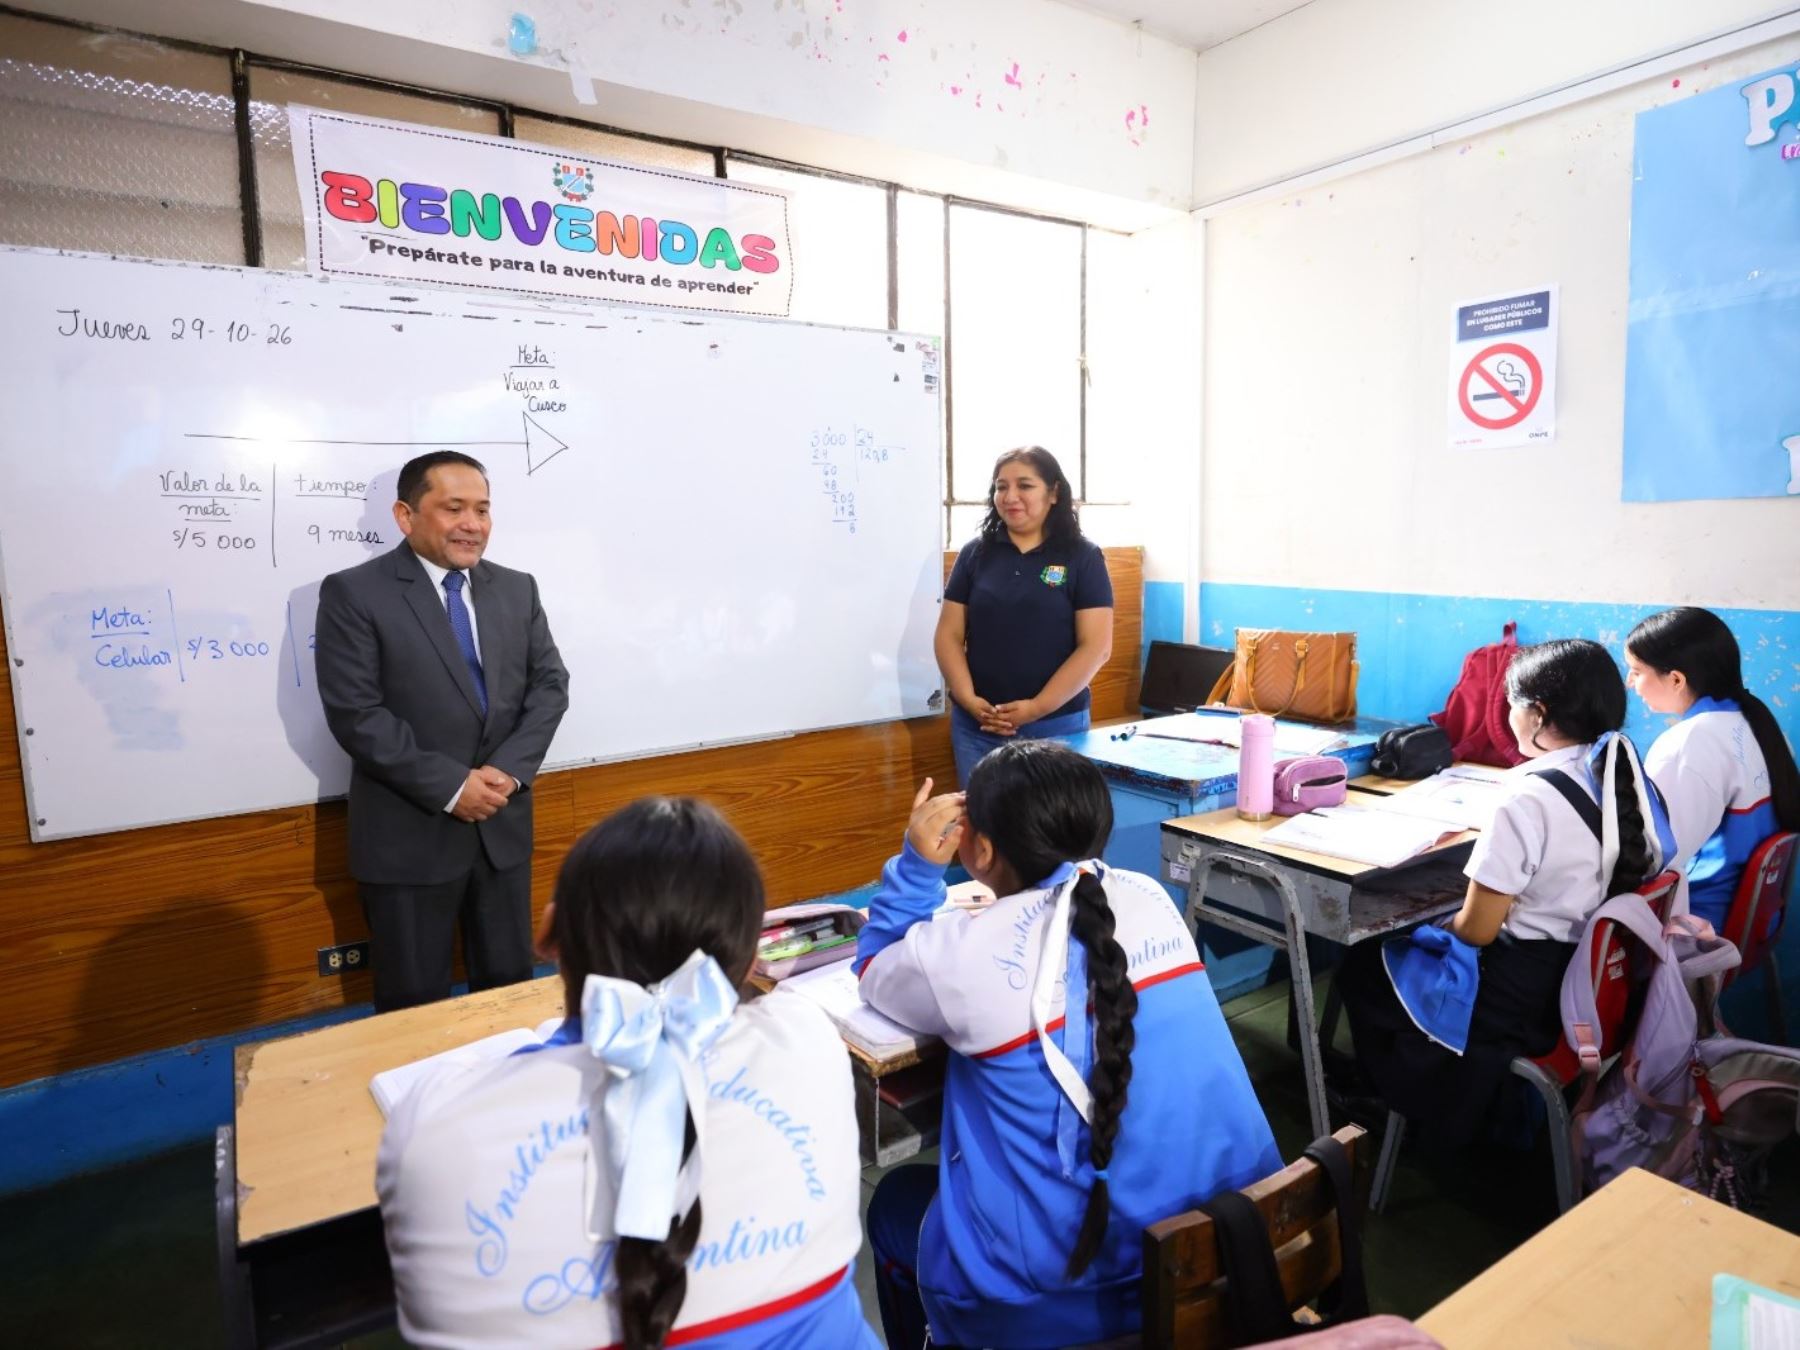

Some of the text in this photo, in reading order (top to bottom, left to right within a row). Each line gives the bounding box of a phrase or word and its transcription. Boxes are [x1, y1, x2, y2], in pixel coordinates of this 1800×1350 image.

[321, 170, 780, 274] BIENVENIDAS
[489, 256, 535, 273] para
[540, 260, 557, 276] la
[563, 265, 646, 285] aventura
[650, 274, 672, 288] de
[1473, 300, 1536, 317] PROHIBIDO FUMAR
[56, 309, 151, 341] Jueves
[1466, 319, 1476, 327] EN
[1476, 314, 1506, 325] LUGARES
[1483, 319, 1523, 332] COMO ESTE
[548, 379, 561, 391] a
[159, 470, 263, 493] Valor de la
[307, 524, 385, 545] 9 meses
[91, 606, 152, 631] Meta:
[95, 643, 173, 668] Celular
